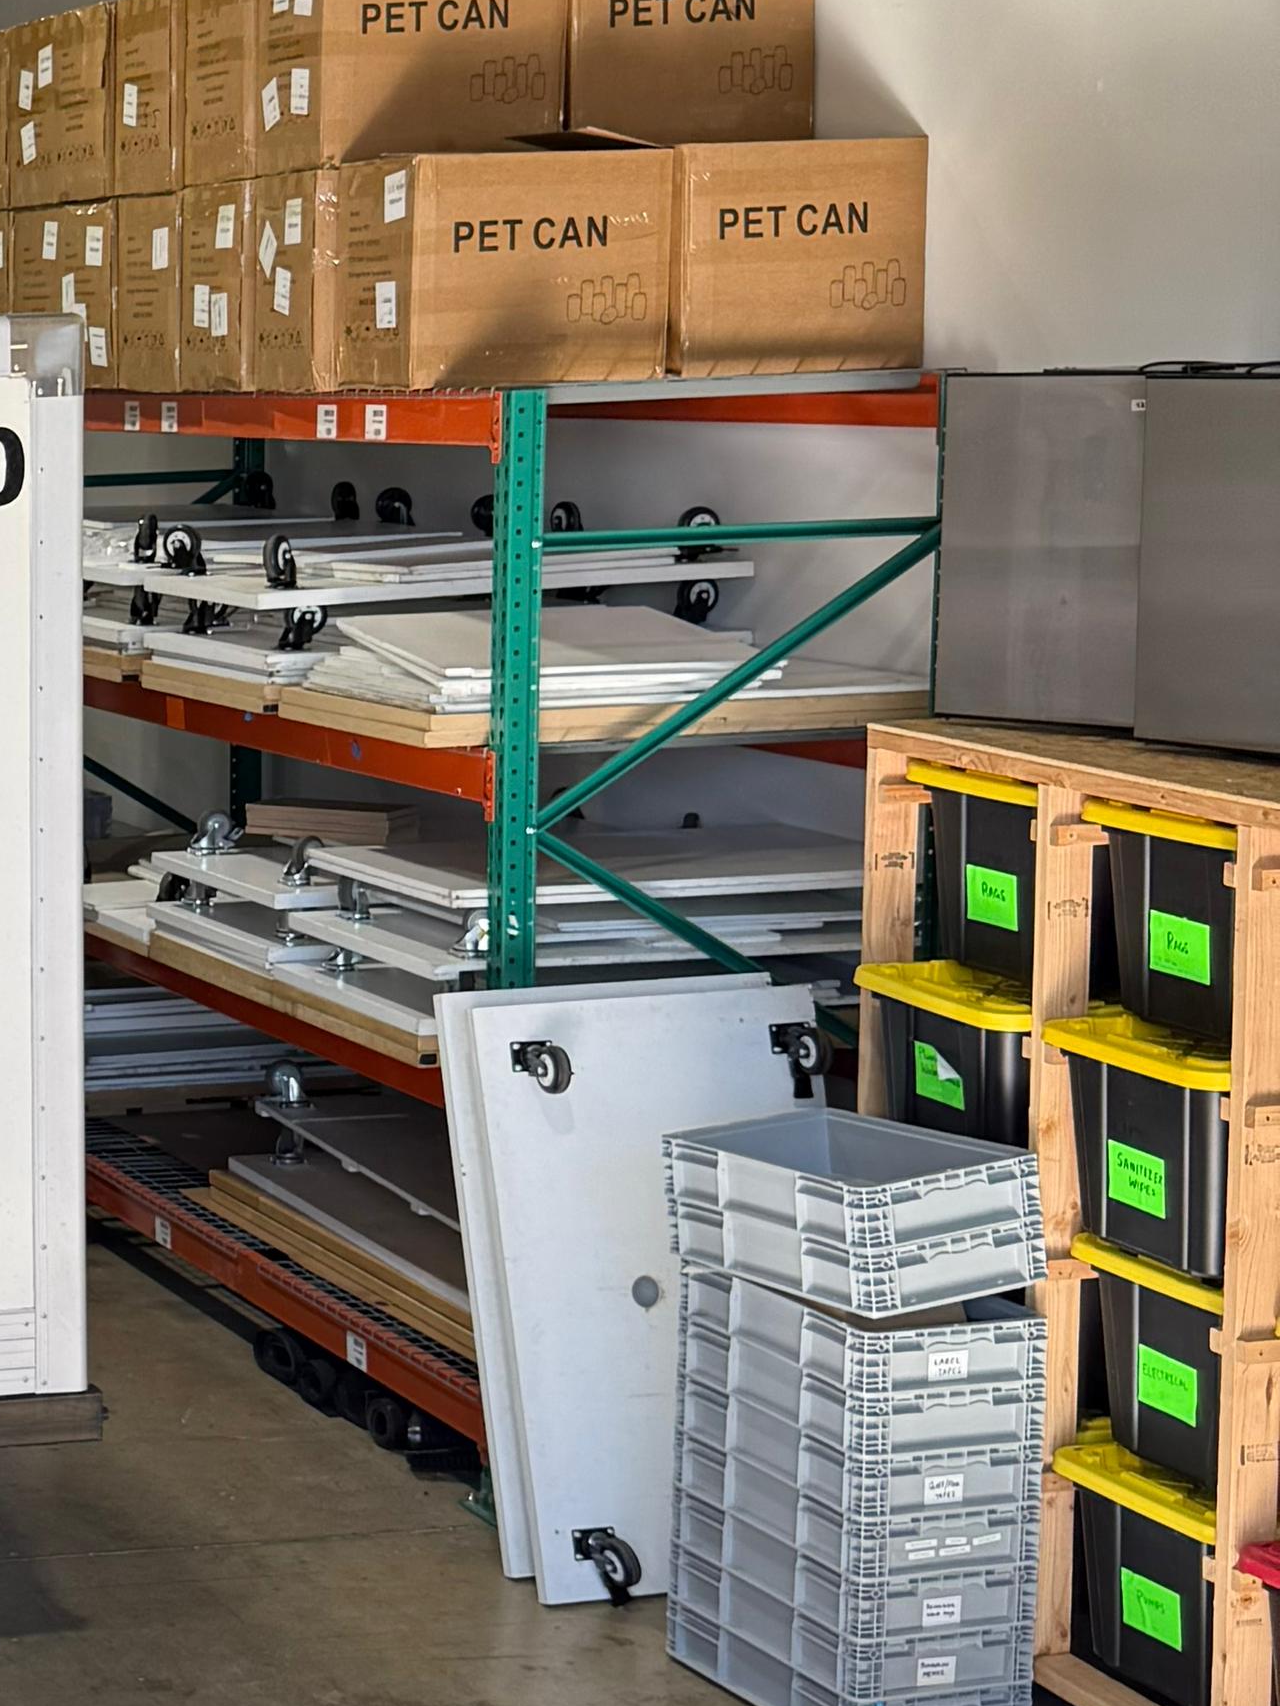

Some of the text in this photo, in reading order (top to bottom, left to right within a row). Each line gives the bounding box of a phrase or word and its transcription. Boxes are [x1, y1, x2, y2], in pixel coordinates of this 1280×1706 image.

[362, 1, 428, 35] PET
[454, 215, 608, 253] PET CAN
[719, 201, 868, 240] PET CAN
